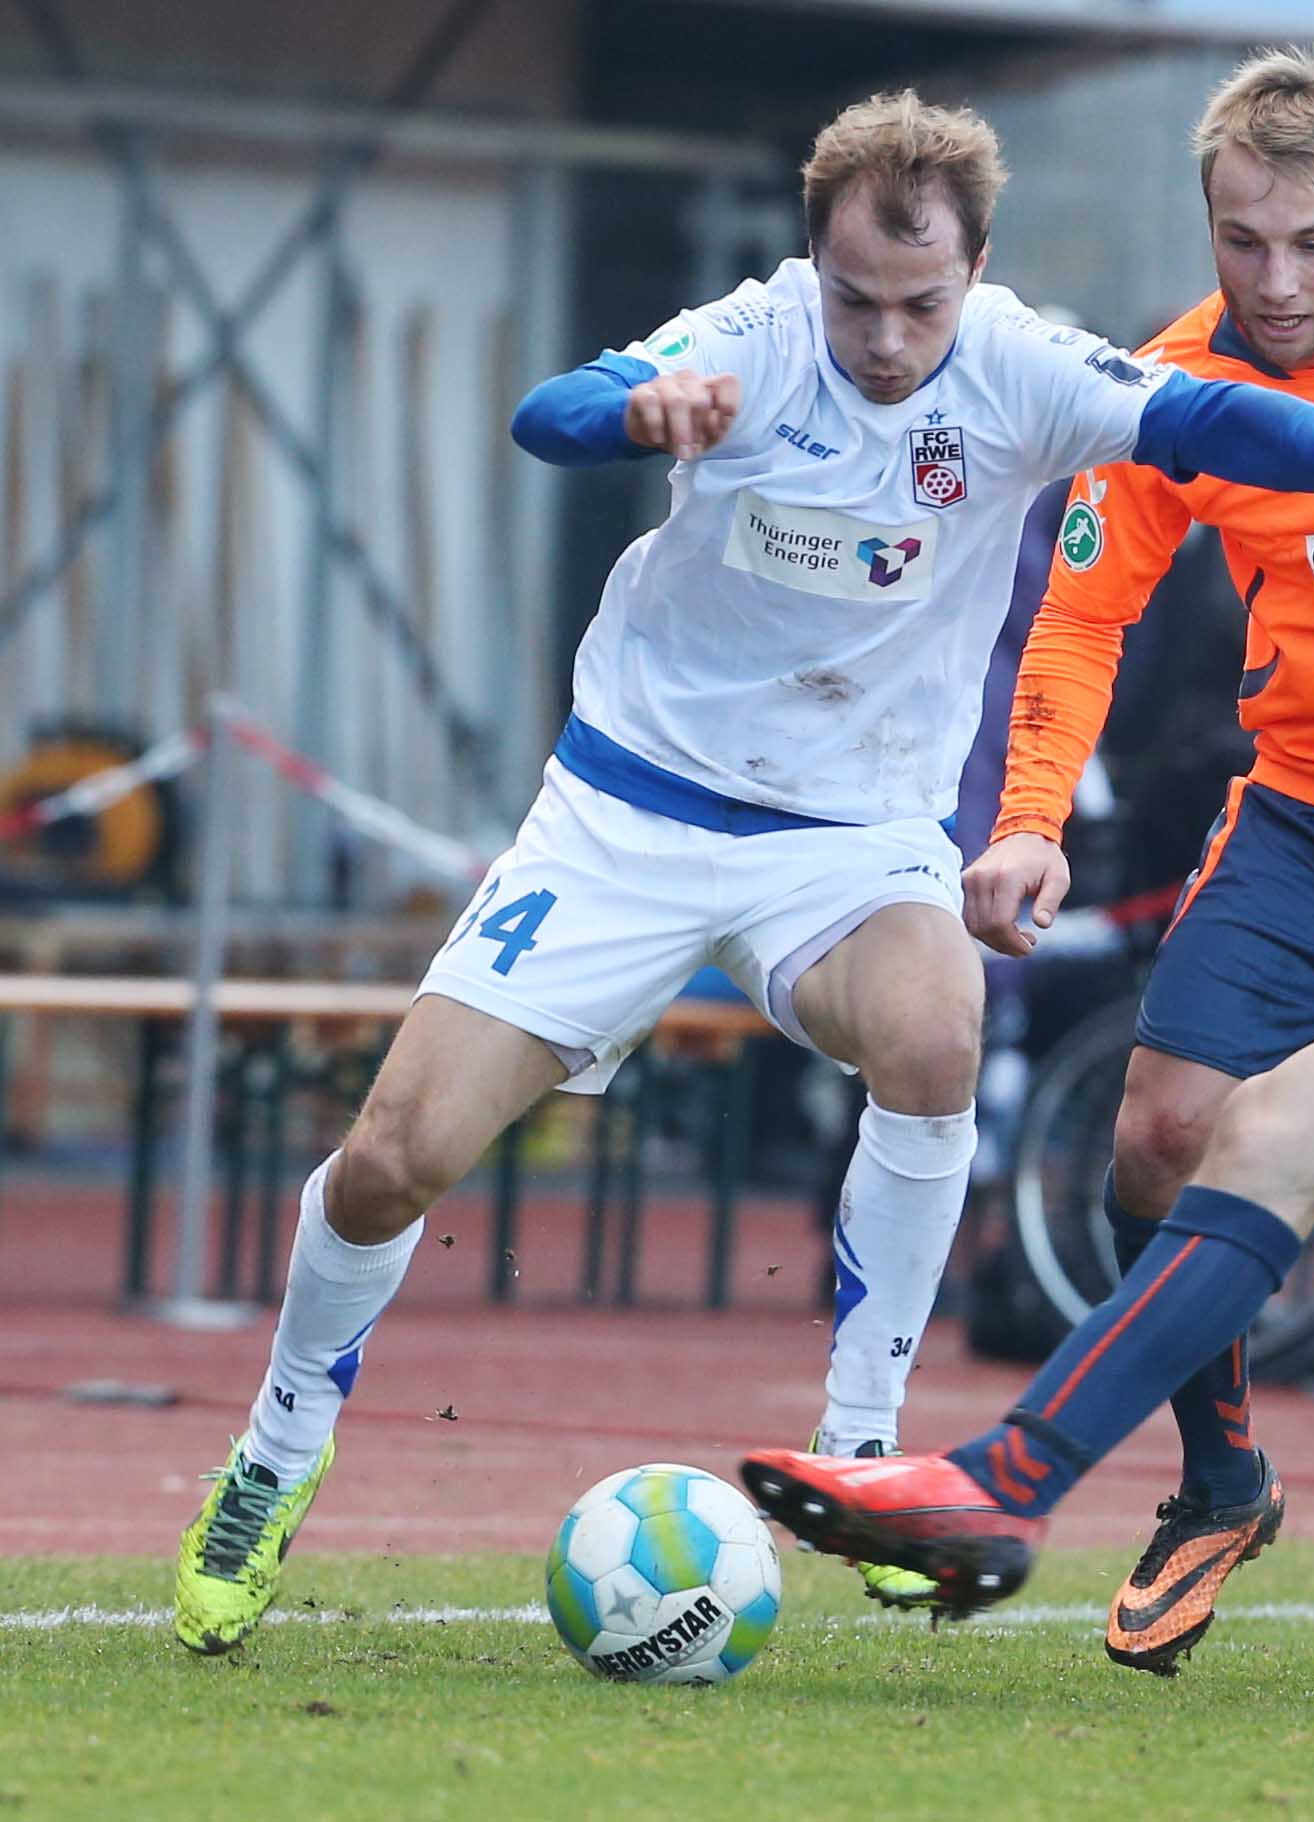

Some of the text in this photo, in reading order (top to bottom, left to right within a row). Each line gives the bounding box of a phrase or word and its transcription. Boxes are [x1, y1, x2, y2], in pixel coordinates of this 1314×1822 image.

[923, 431, 949, 446] FC
[915, 444, 961, 461] RWE
[749, 512, 843, 551] Thüringer
[763, 540, 840, 570] Energie
[890, 1337, 913, 1357] 34
[591, 1595, 722, 1676] DERBYSTAR
